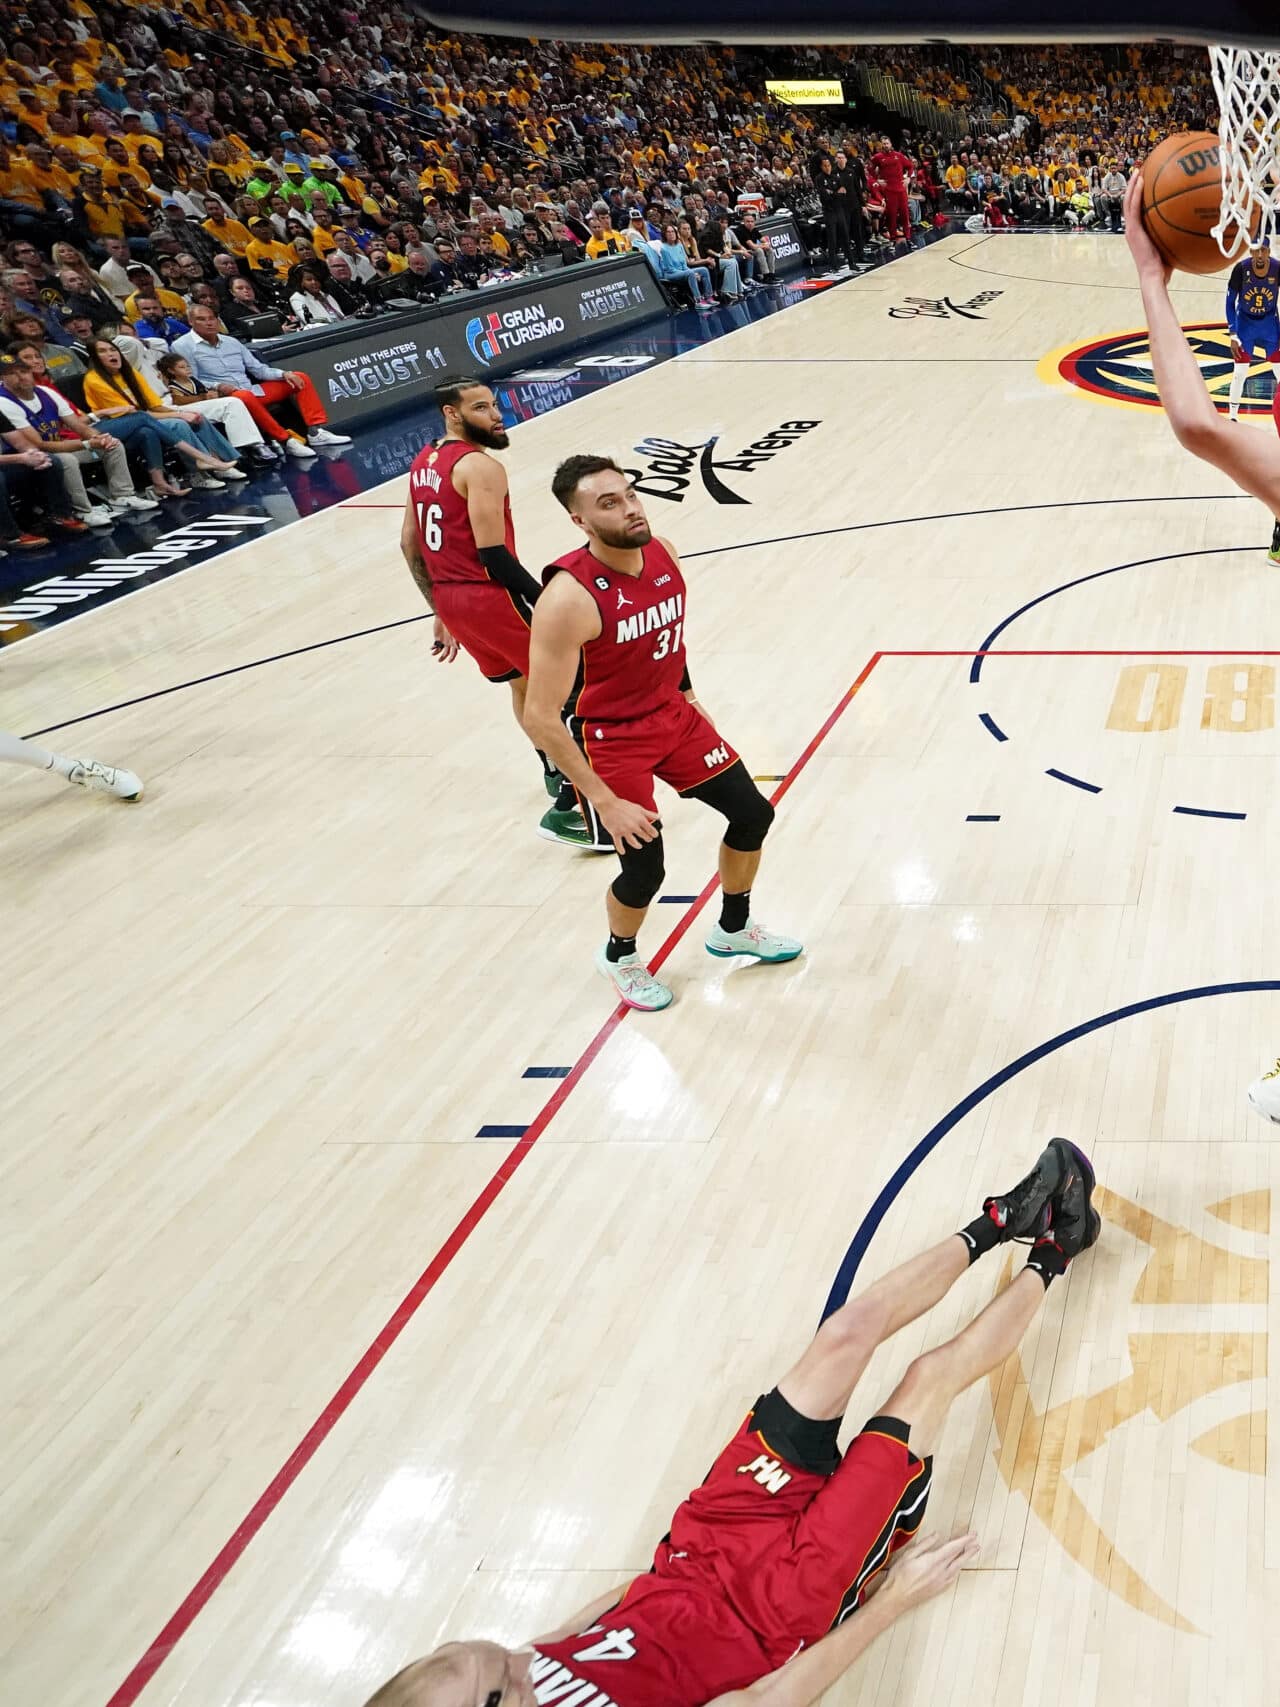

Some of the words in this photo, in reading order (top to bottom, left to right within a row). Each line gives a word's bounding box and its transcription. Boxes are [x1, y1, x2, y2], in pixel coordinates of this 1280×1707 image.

[771, 232, 791, 247] GRAN
[773, 242, 801, 259] URISMO
[502, 303, 546, 329] GRAN
[578, 289, 632, 321] AUGUST
[631, 285, 645, 303] 11
[1255, 295, 1263, 307] 5
[498, 316, 565, 349] TURISMO
[333, 358, 358, 373] ONLY
[359, 354, 372, 365] IN
[370, 341, 417, 361] THEATERS
[328, 353, 422, 402] AUGUST
[425, 346, 447, 370] 11
[712, 420, 823, 473] Arena
[412, 467, 442, 494] MARTIN
[595, 577, 609, 590] 6
[616, 593, 682, 644] MIAMI
[652, 621, 682, 661] 31
